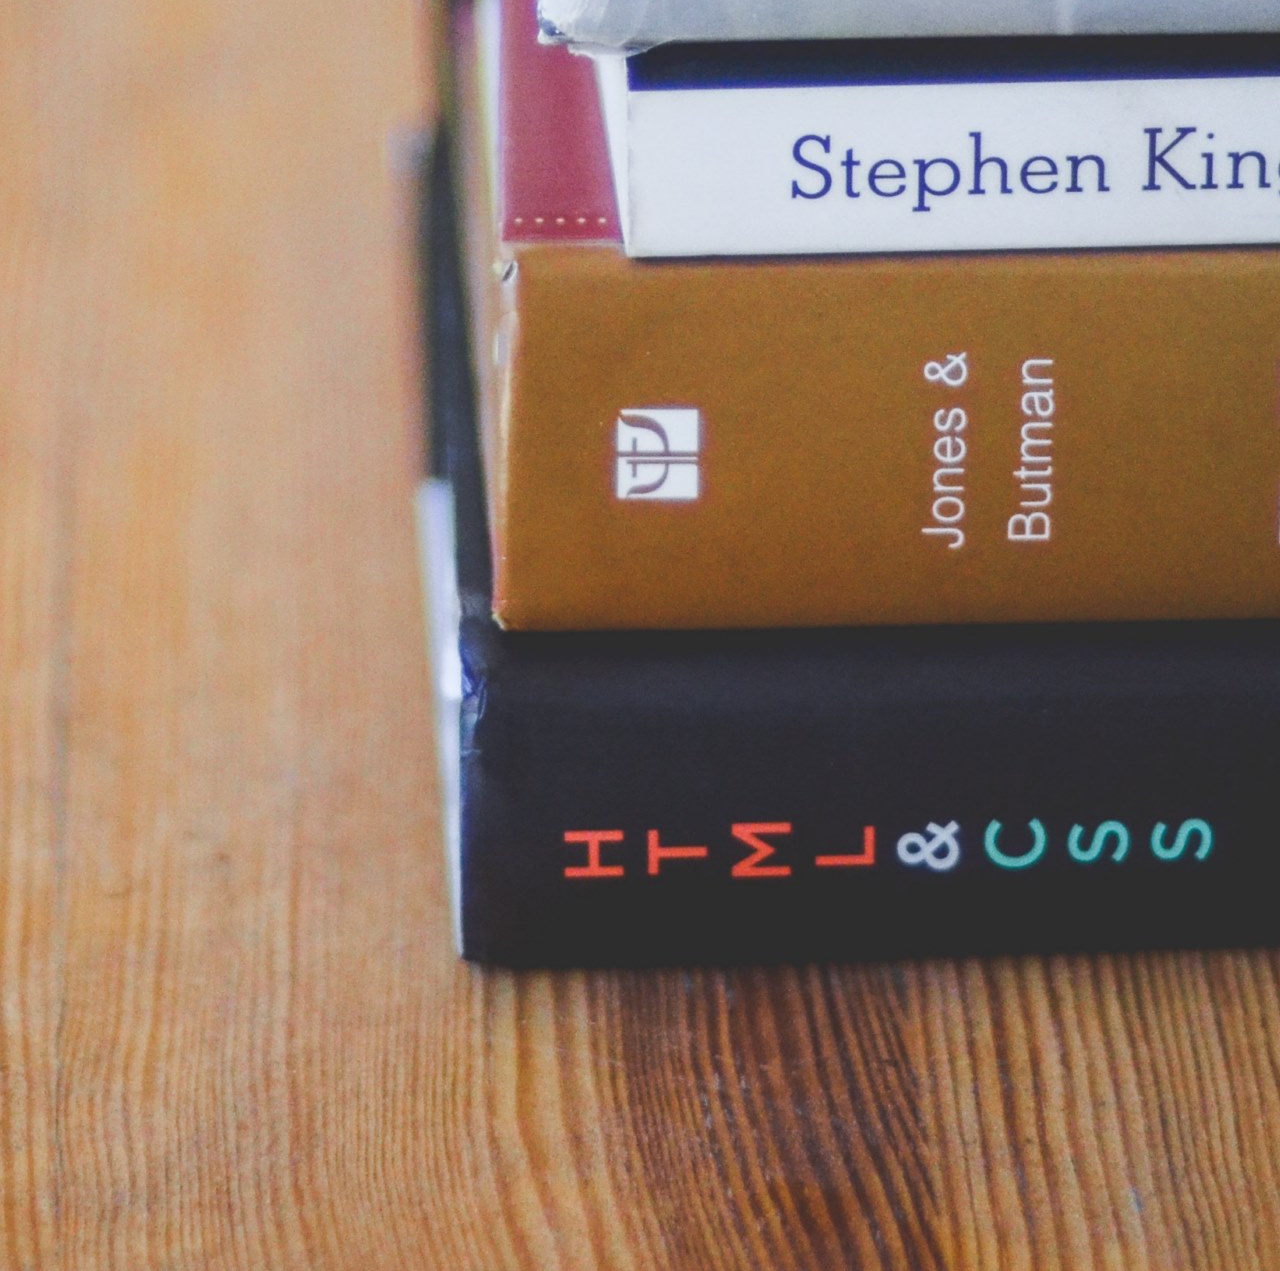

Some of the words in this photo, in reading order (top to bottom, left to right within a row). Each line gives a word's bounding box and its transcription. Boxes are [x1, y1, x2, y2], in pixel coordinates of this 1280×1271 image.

[791, 131, 1111, 213] Stephen
[923, 352, 968, 387] &
[921, 407, 968, 549] Jones
[1007, 358, 1055, 541] Butman
